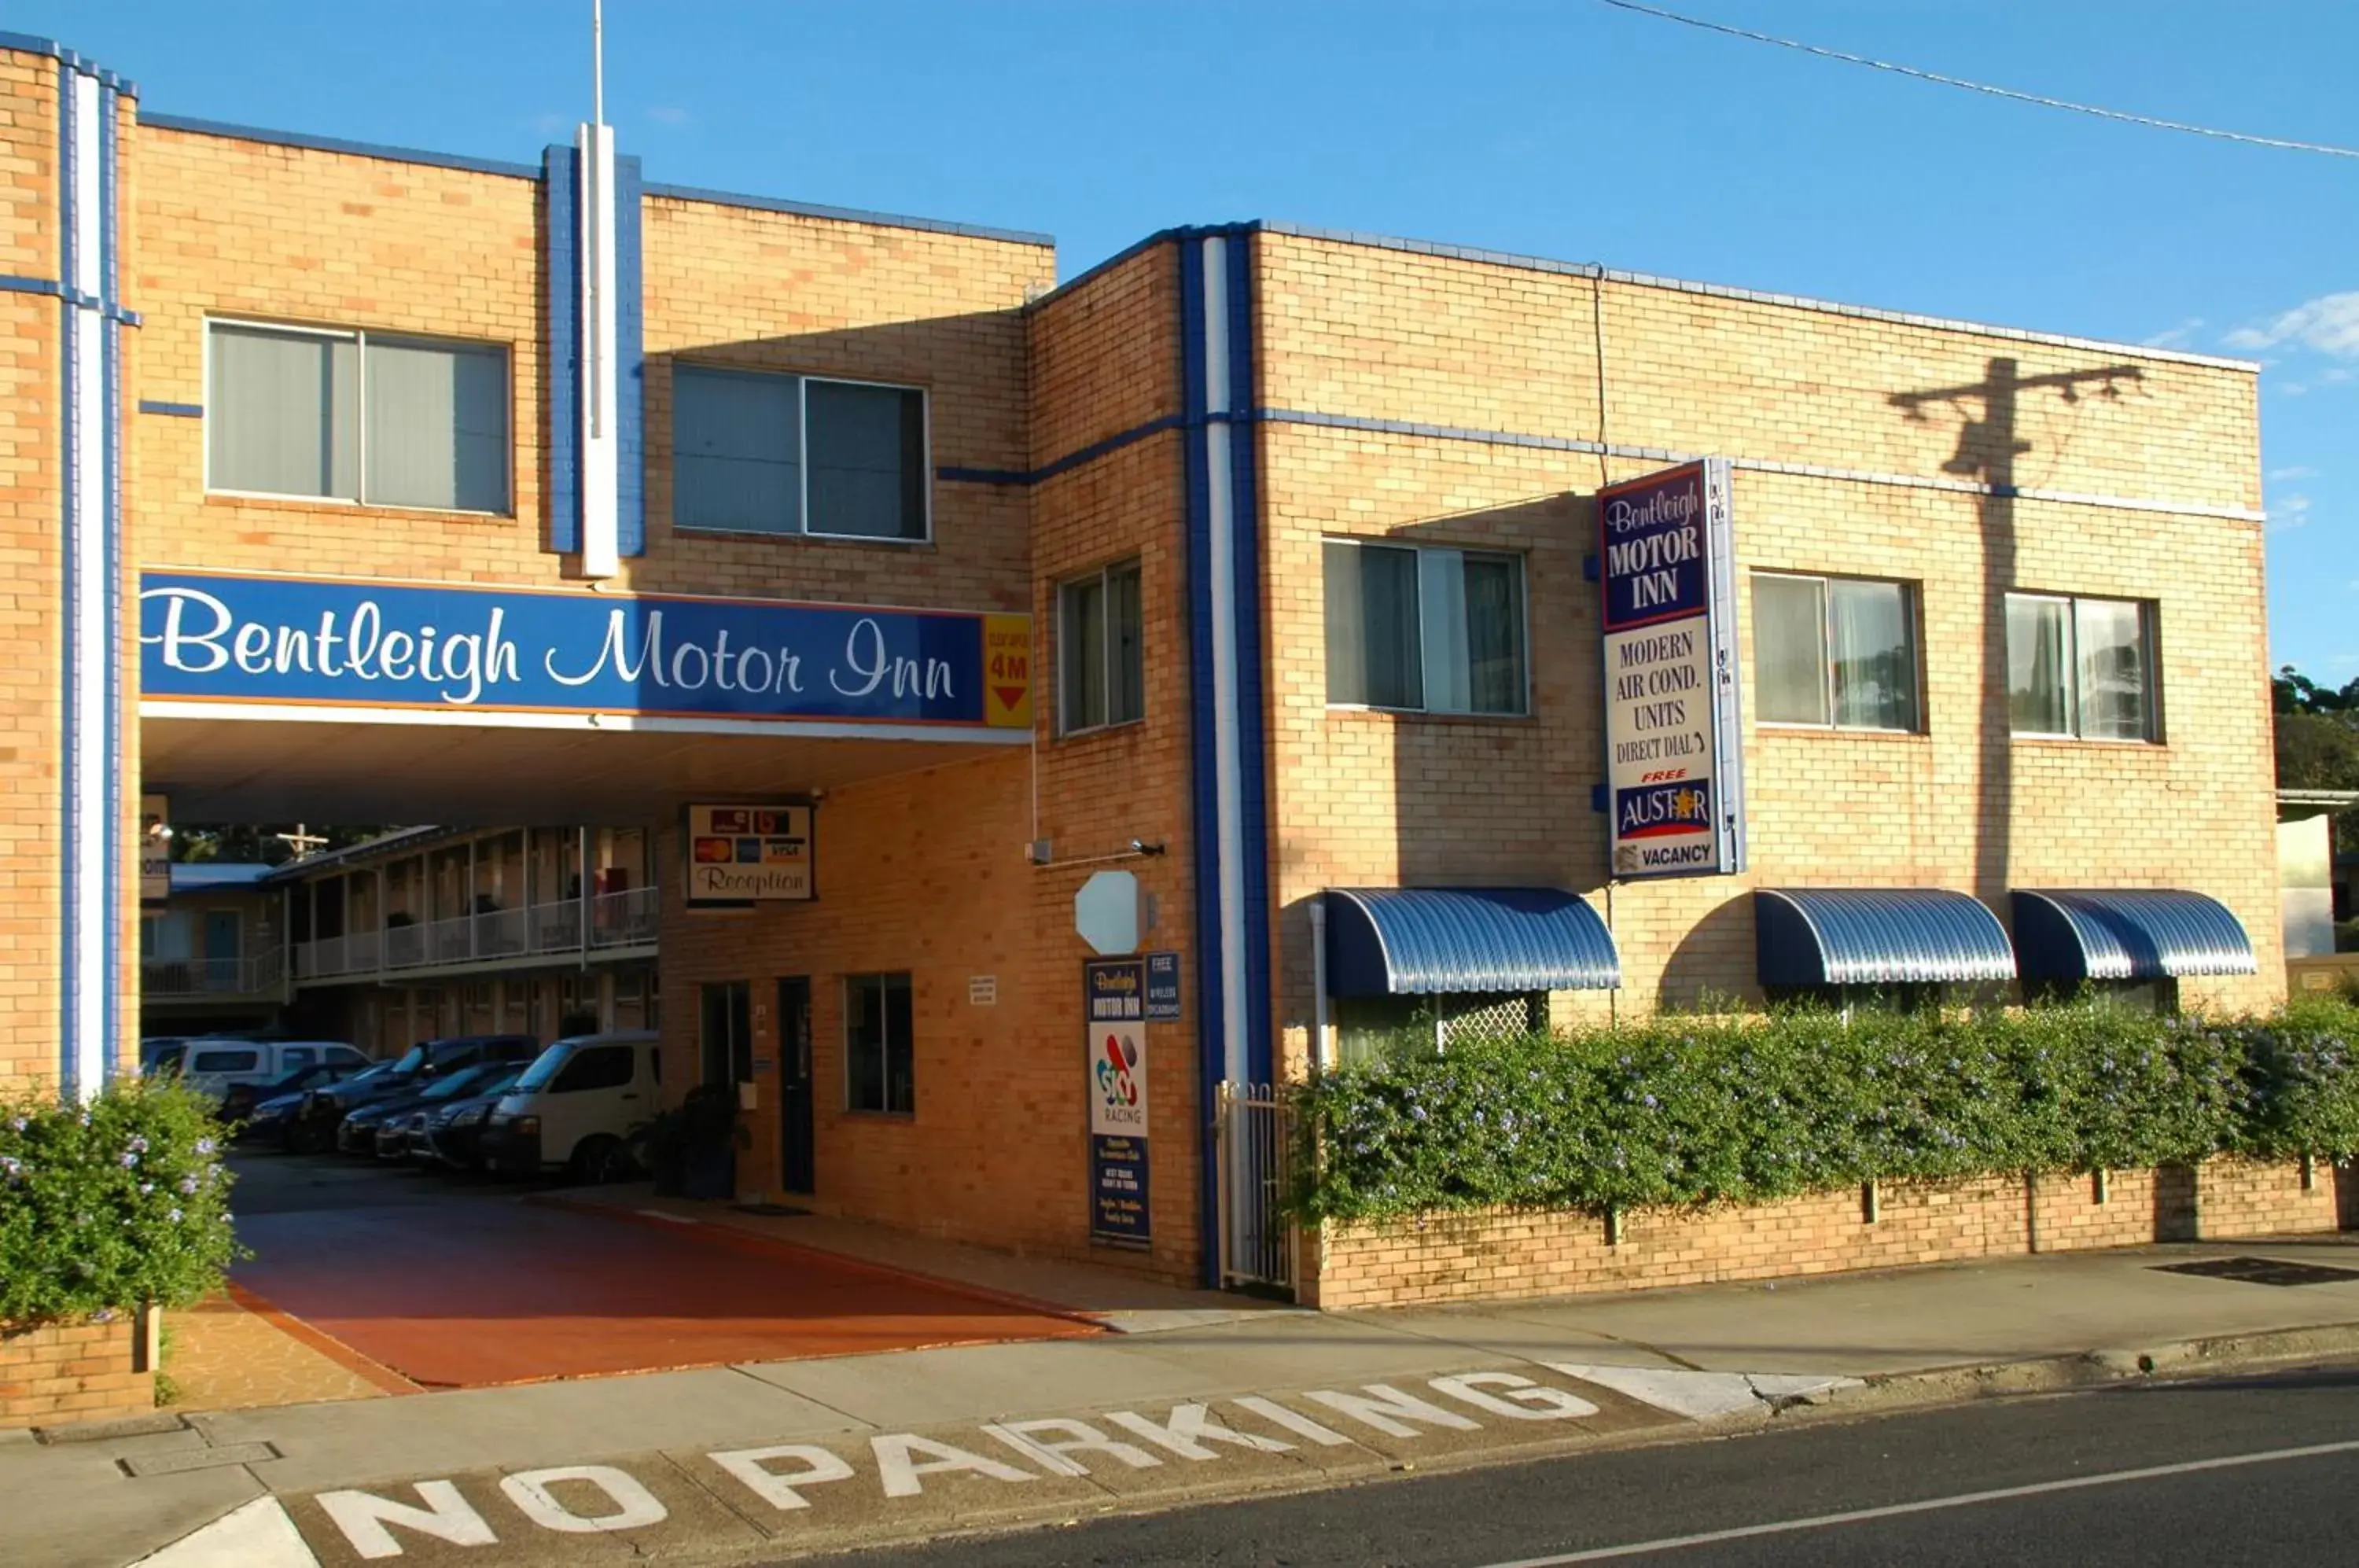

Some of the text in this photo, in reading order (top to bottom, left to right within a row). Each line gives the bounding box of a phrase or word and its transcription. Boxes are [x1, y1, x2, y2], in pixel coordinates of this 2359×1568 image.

[1606, 481, 1698, 533] Bentleigh
[1607, 527, 1699, 578] MOTOR
[1632, 567, 1679, 609] INN
[140, 587, 955, 704] Bentleigh Motor Inn
[1620, 631, 1694, 668] MODERN
[1616, 664, 1702, 702] AIR COND.
[1634, 699, 1686, 731] UNITS
[1617, 733, 1694, 764] DIRECT DIAL
[1641, 767, 1687, 783] FREE
[1643, 845, 1712, 866] VACANCY
[697, 867, 804, 896] Reception
[1093, 996, 1140, 1018] MOTOR INN
[1100, 1068, 1132, 1099] SKY
[1105, 1107, 1142, 1124] RACING
[316, 1371, 1600, 1559] NO PARKING
